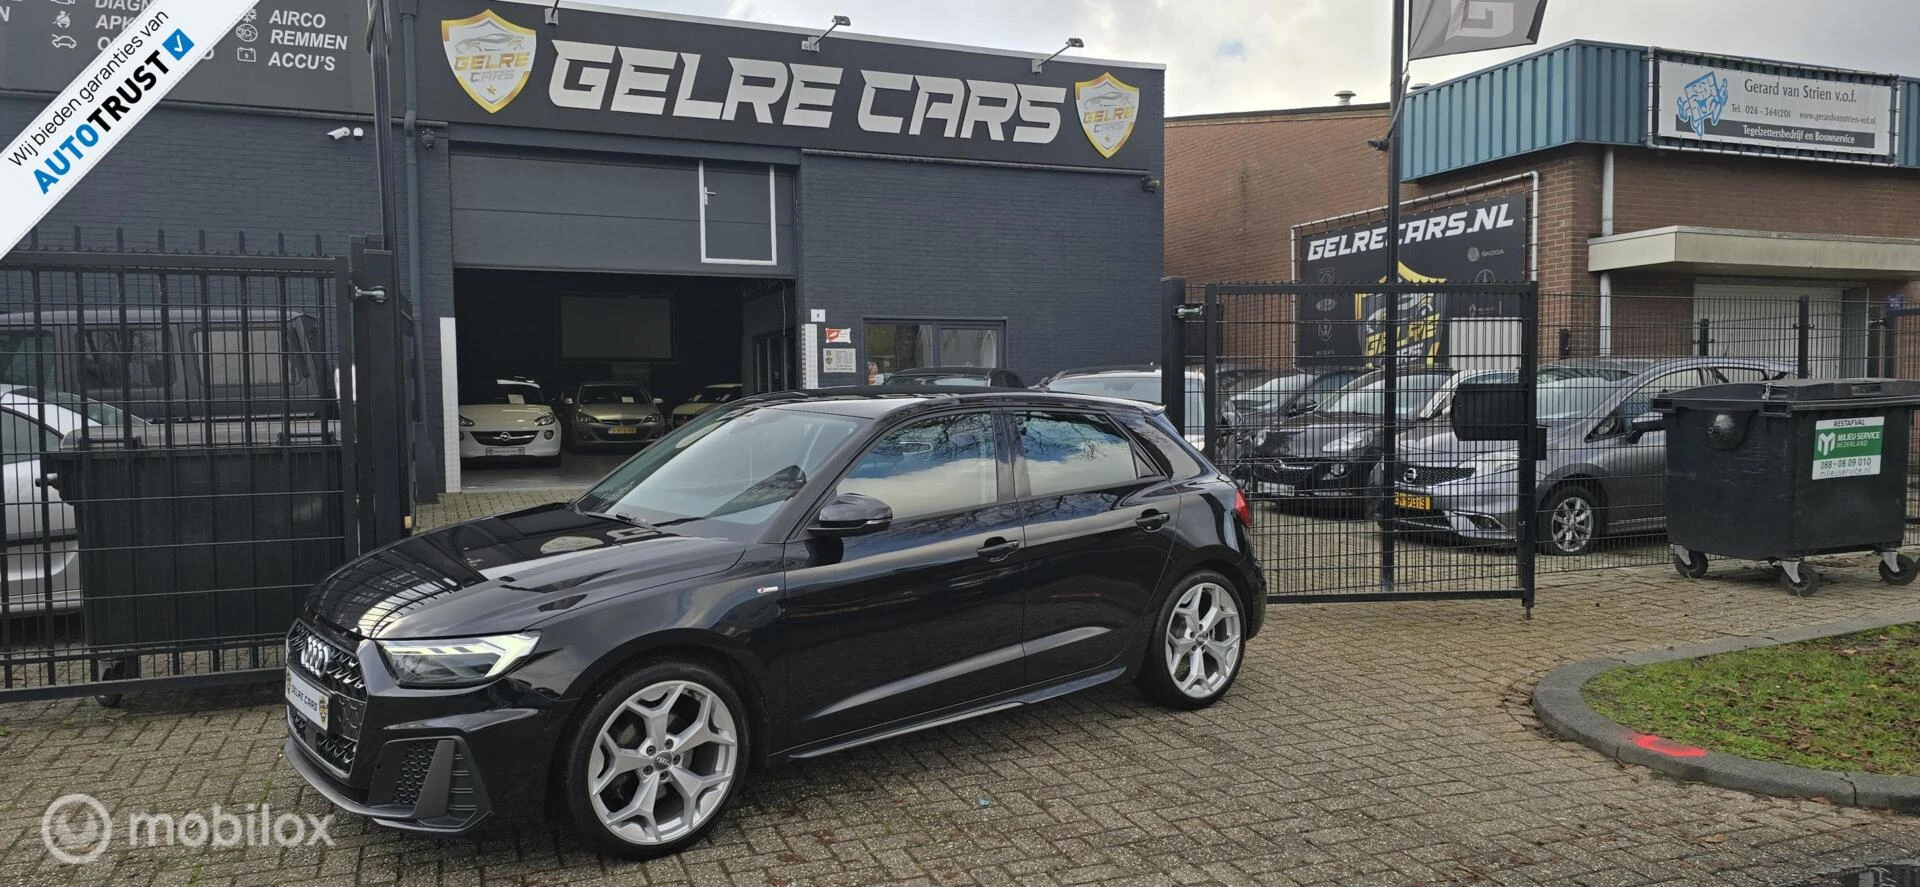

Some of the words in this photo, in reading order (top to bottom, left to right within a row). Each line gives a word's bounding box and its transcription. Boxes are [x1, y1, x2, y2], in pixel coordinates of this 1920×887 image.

[269, 9, 326, 28] AIRCO
[270, 29, 348, 50] REMMEN
[268, 51, 336, 71] ACCU'S
[454, 52, 530, 71] GELRE
[470, 69, 515, 82] CARS
[548, 39, 844, 128] GELRE
[857, 69, 1067, 144] CARS
[1744, 78, 1779, 96] Gerard
[1782, 86, 1800, 97] van
[1803, 84, 1832, 100] Strien
[1835, 89, 1857, 103] v.o.f.
[1083, 106, 1135, 123] GELRE
[1731, 103, 1742, 113] Tel.
[1745, 105, 1758, 115] 026
[1764, 107, 1791, 118] 3641201
[1743, 124, 1804, 142] Tegelzettersbedrijf
[1805, 133, 1814, 141] en
[1815, 131, 1856, 144] Bouwservice
[1833, 419, 1865, 428] RESTAFVAL
[1838, 433, 1856, 441] MILIEU
[1856, 431, 1880, 440] SERVICE
[1820, 461, 1833, 470] 088
[1838, 459, 1847, 468] 08
[1848, 458, 1857, 467] 09
[1858, 457, 1872, 466] 010
